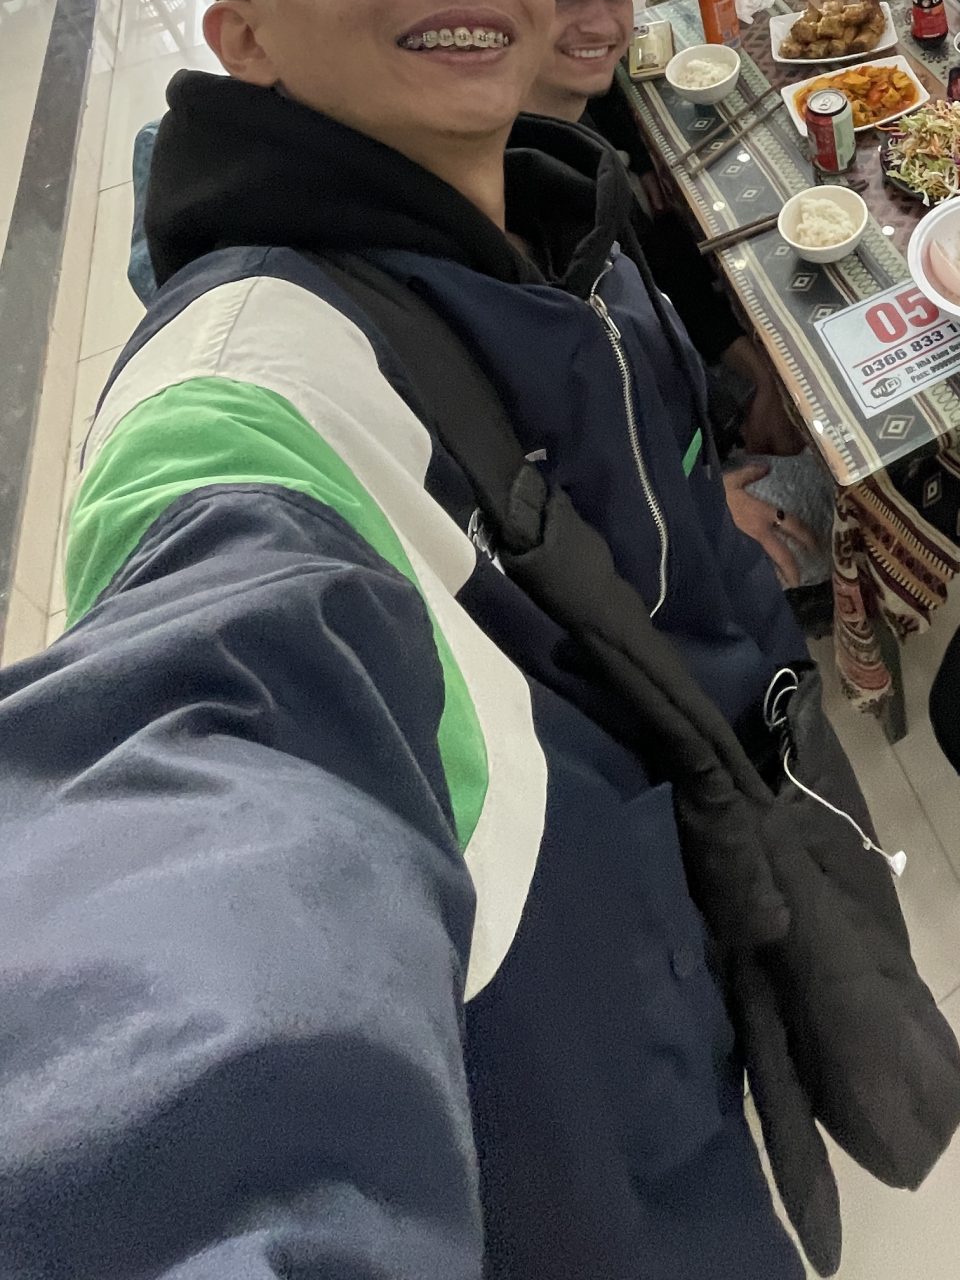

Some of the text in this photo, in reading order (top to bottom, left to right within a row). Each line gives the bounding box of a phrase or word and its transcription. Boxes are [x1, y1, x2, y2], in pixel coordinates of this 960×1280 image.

[865, 286, 940, 344] 05
[861, 348, 907, 376] 0366
[910, 330, 944, 352] 833
